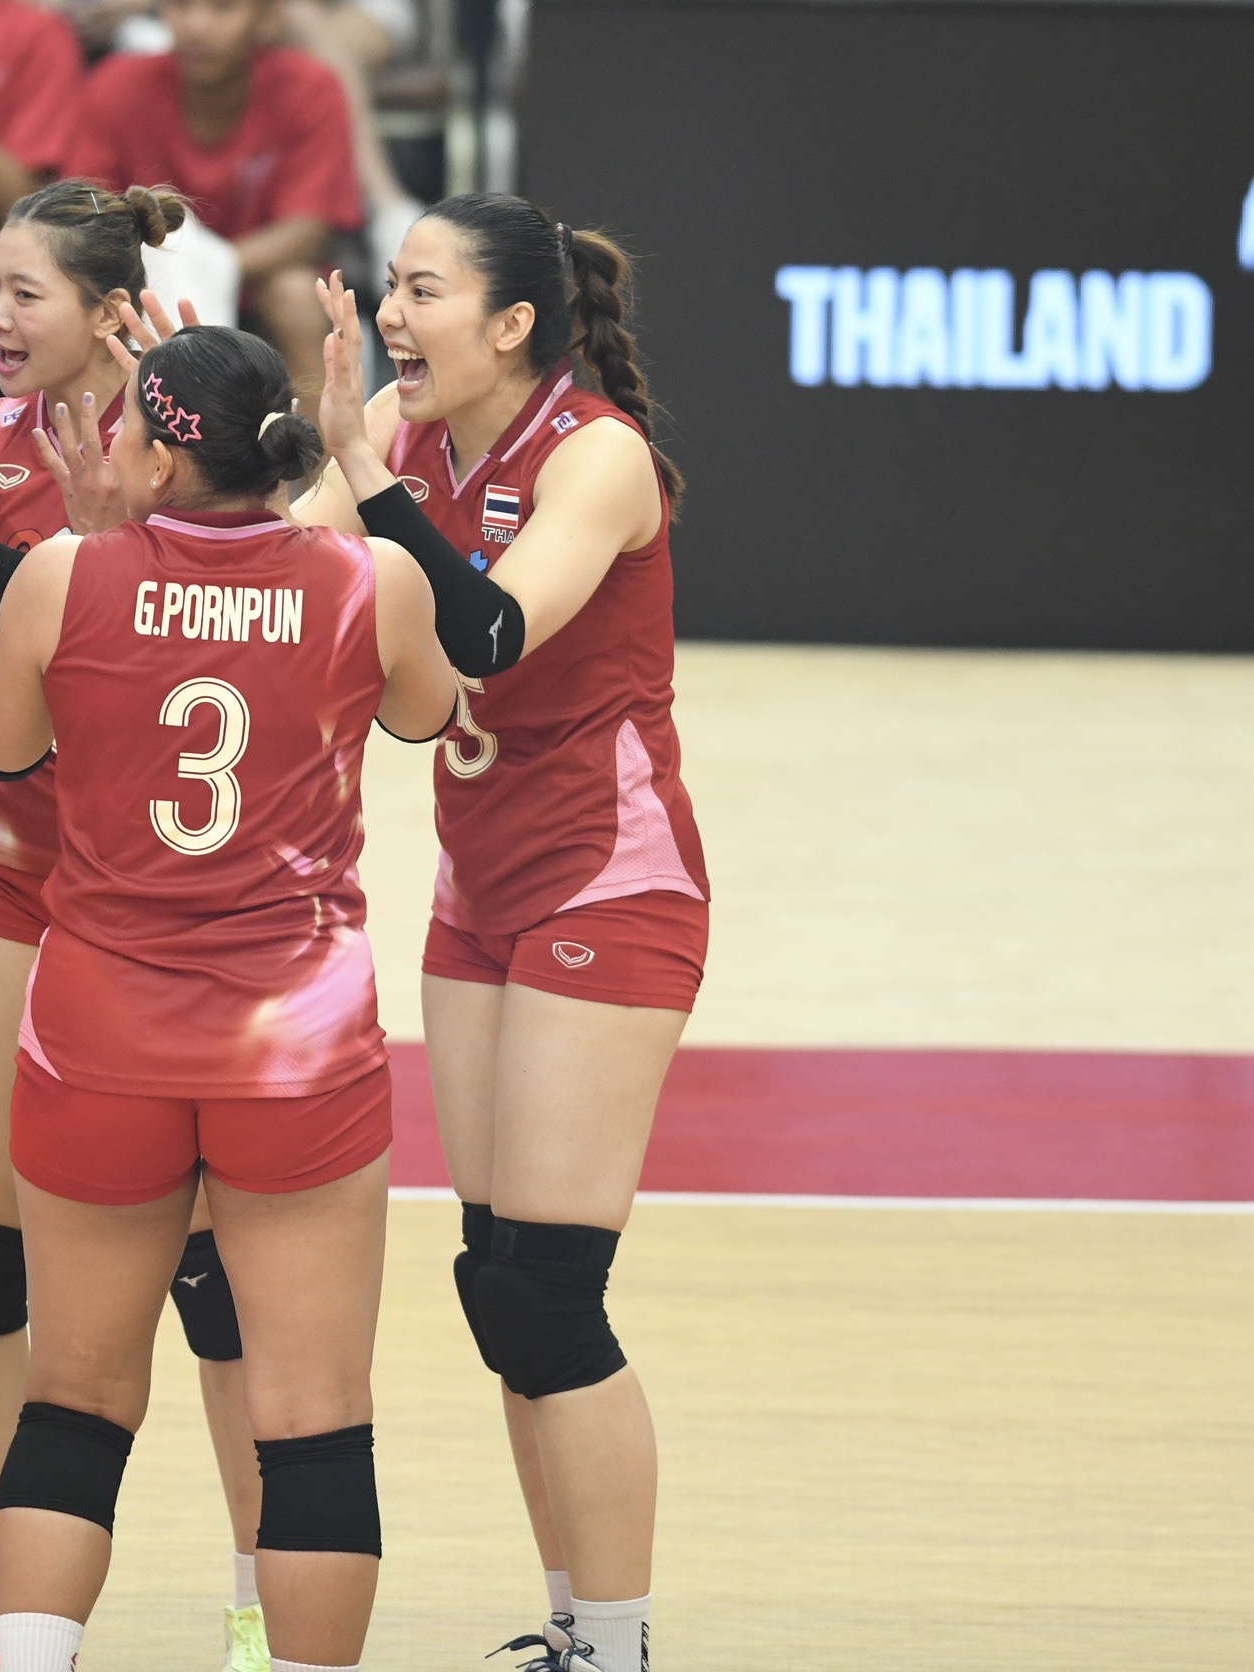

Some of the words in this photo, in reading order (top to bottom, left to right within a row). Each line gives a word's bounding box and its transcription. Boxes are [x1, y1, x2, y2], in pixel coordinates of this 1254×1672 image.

[775, 265, 1213, 392] THAILAND
[481, 526, 515, 544] THA
[134, 580, 304, 644] G.PORNPUN
[149, 676, 251, 856] 3
